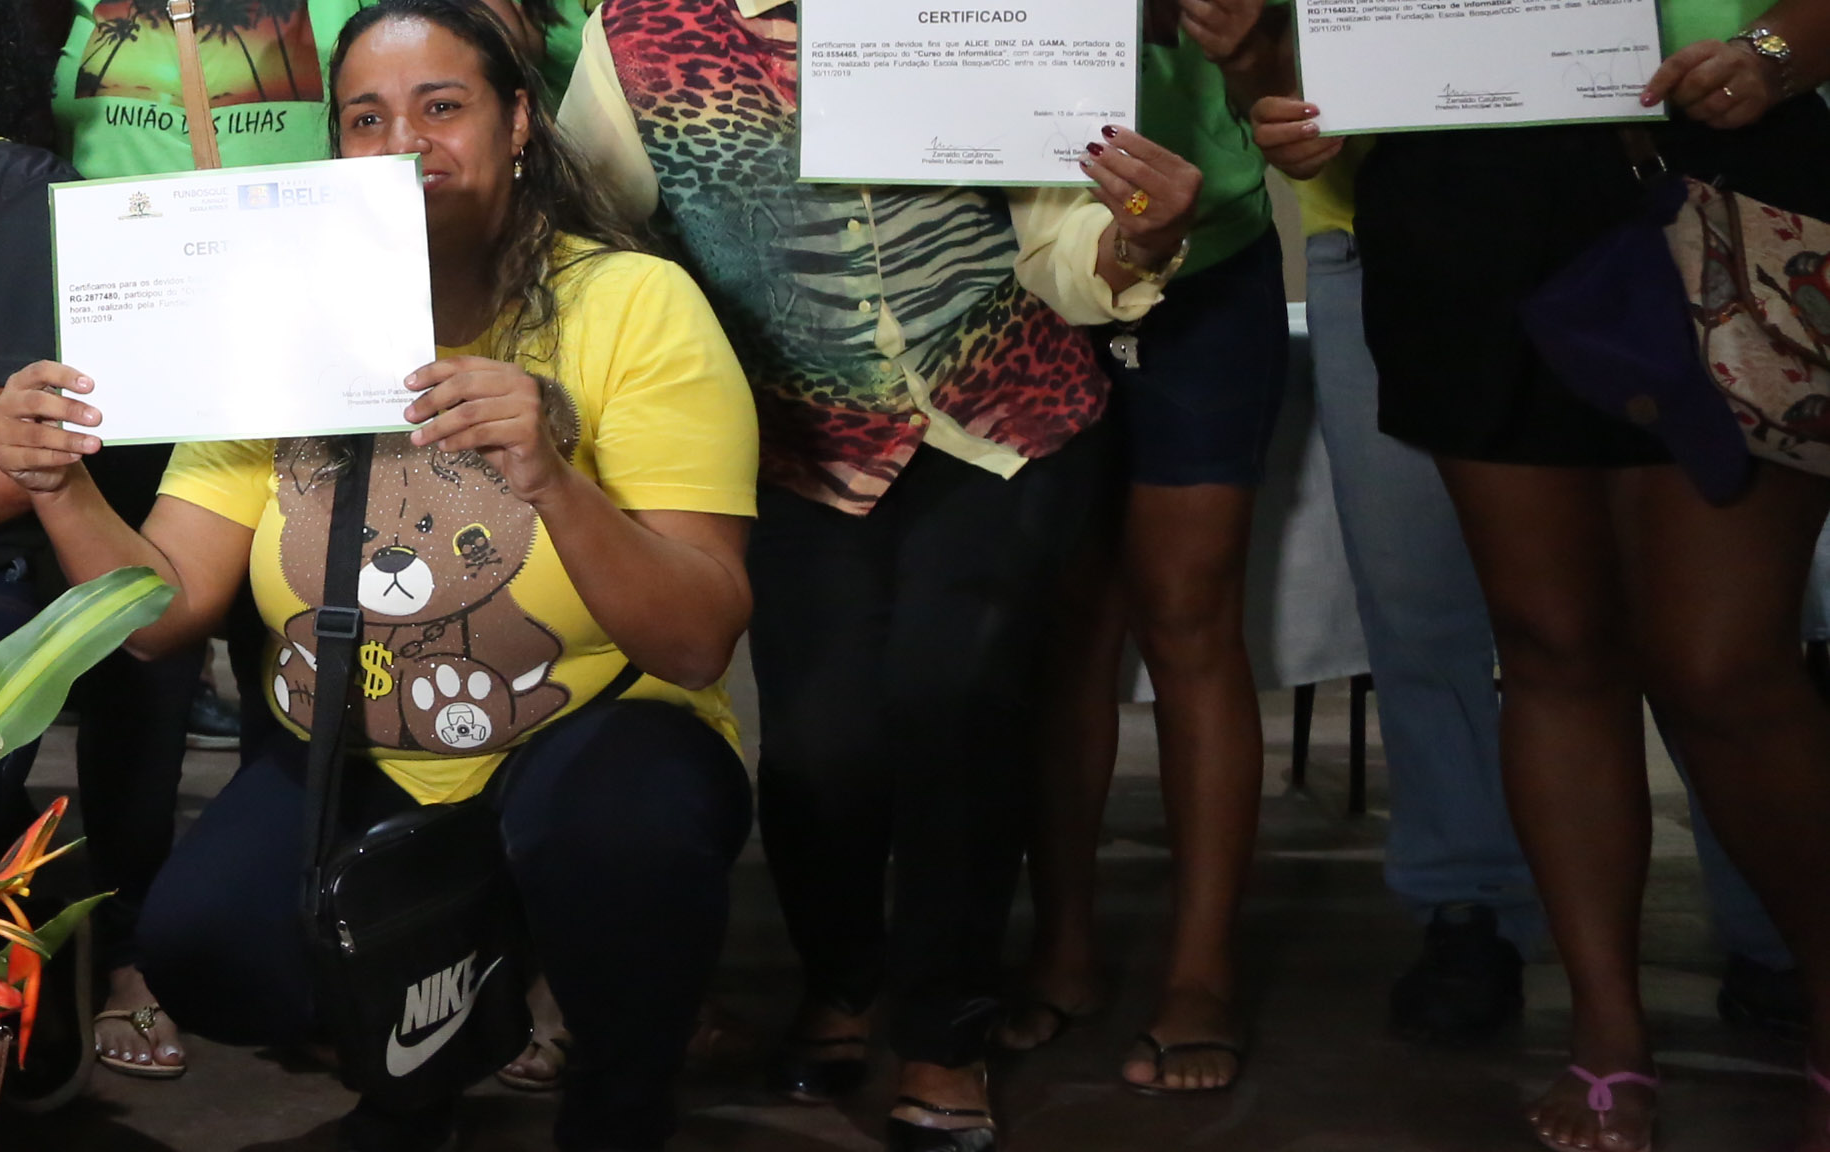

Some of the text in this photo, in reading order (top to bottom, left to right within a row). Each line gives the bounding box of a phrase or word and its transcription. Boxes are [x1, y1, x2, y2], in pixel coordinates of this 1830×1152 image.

[917, 9, 1027, 23] CERTIFICADO
[927, 39, 940, 47] fins
[964, 39, 989, 47] ALICE
[862, 50, 897, 58] participou
[913, 49, 941, 57] "Curso
[1096, 49, 1107, 57] de
[873, 60, 889, 68] pela
[893, 59, 929, 68] Fundação
[106, 104, 173, 131] UNIÃO
[228, 109, 287, 134] ILHAS
[172, 186, 228, 199] FUNBOSQUE
[68, 282, 116, 292] Certificamos
[118, 281, 137, 289] para
[139, 279, 150, 287] os
[123, 290, 162, 300] participou
[97, 302, 133, 311] realizado
[137, 300, 154, 310] pela
[401, 950, 477, 1036] NIKE
